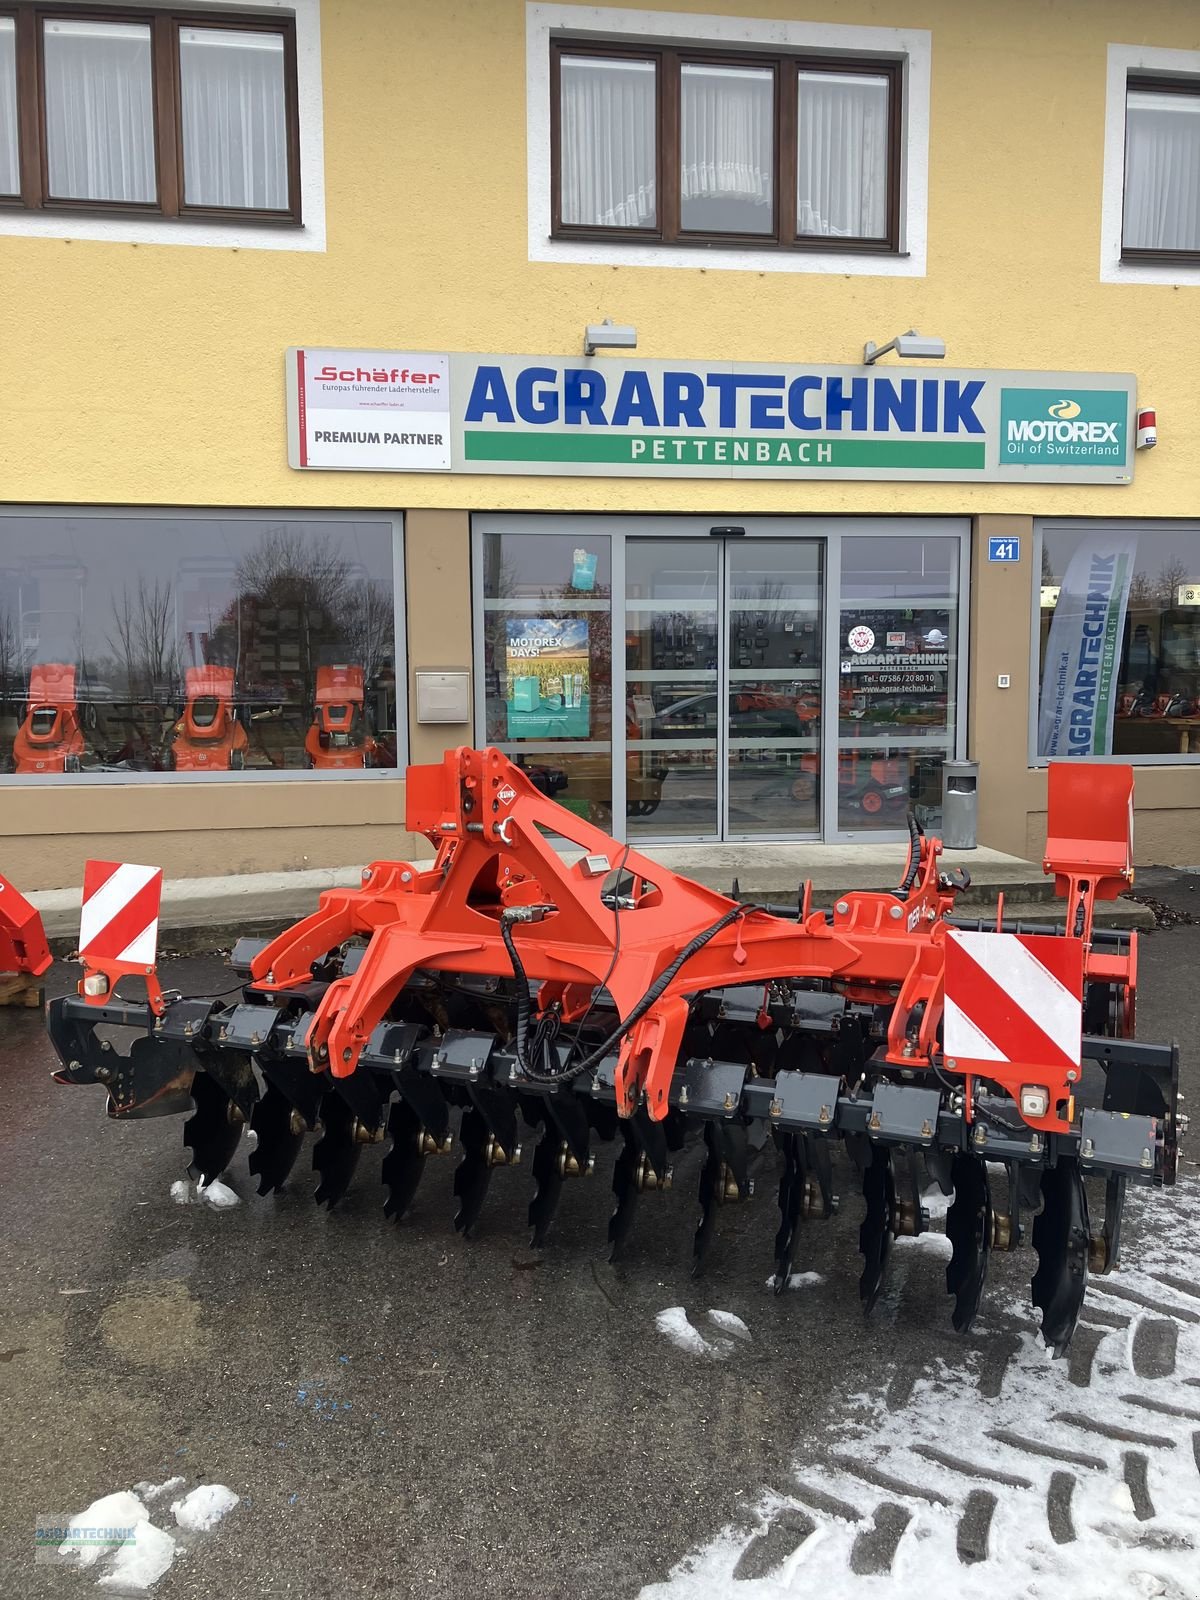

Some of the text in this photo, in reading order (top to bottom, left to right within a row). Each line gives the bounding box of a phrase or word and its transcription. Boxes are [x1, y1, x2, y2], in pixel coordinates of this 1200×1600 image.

[314, 367, 441, 384] Schäffer
[322, 383, 440, 394] Europas führender Laderhersteller
[464, 365, 987, 434] AGRARTECHNIK
[314, 430, 443, 446] PREMIUM PARTNER
[1007, 420, 1118, 444] MOTOREX
[631, 439, 833, 464] PETTENBACH
[1007, 443, 1119, 457] Oil of Switzerland
[995, 543, 1013, 559] 41
[510, 638, 562, 647] MOTOREX
[510, 648, 540, 657] DAYS!
[850, 653, 948, 665] AGRARTECHNIK
[1068, 553, 1116, 756] AGRARTECHNIK
[1099, 617, 1117, 701] PETTENBACH
[879, 674, 901, 682] 07586
[906, 674, 915, 682] 20
[915, 674, 925, 682] 80
[925, 674, 935, 682] 10
[861, 684, 937, 694] www.agrar-technik.at
